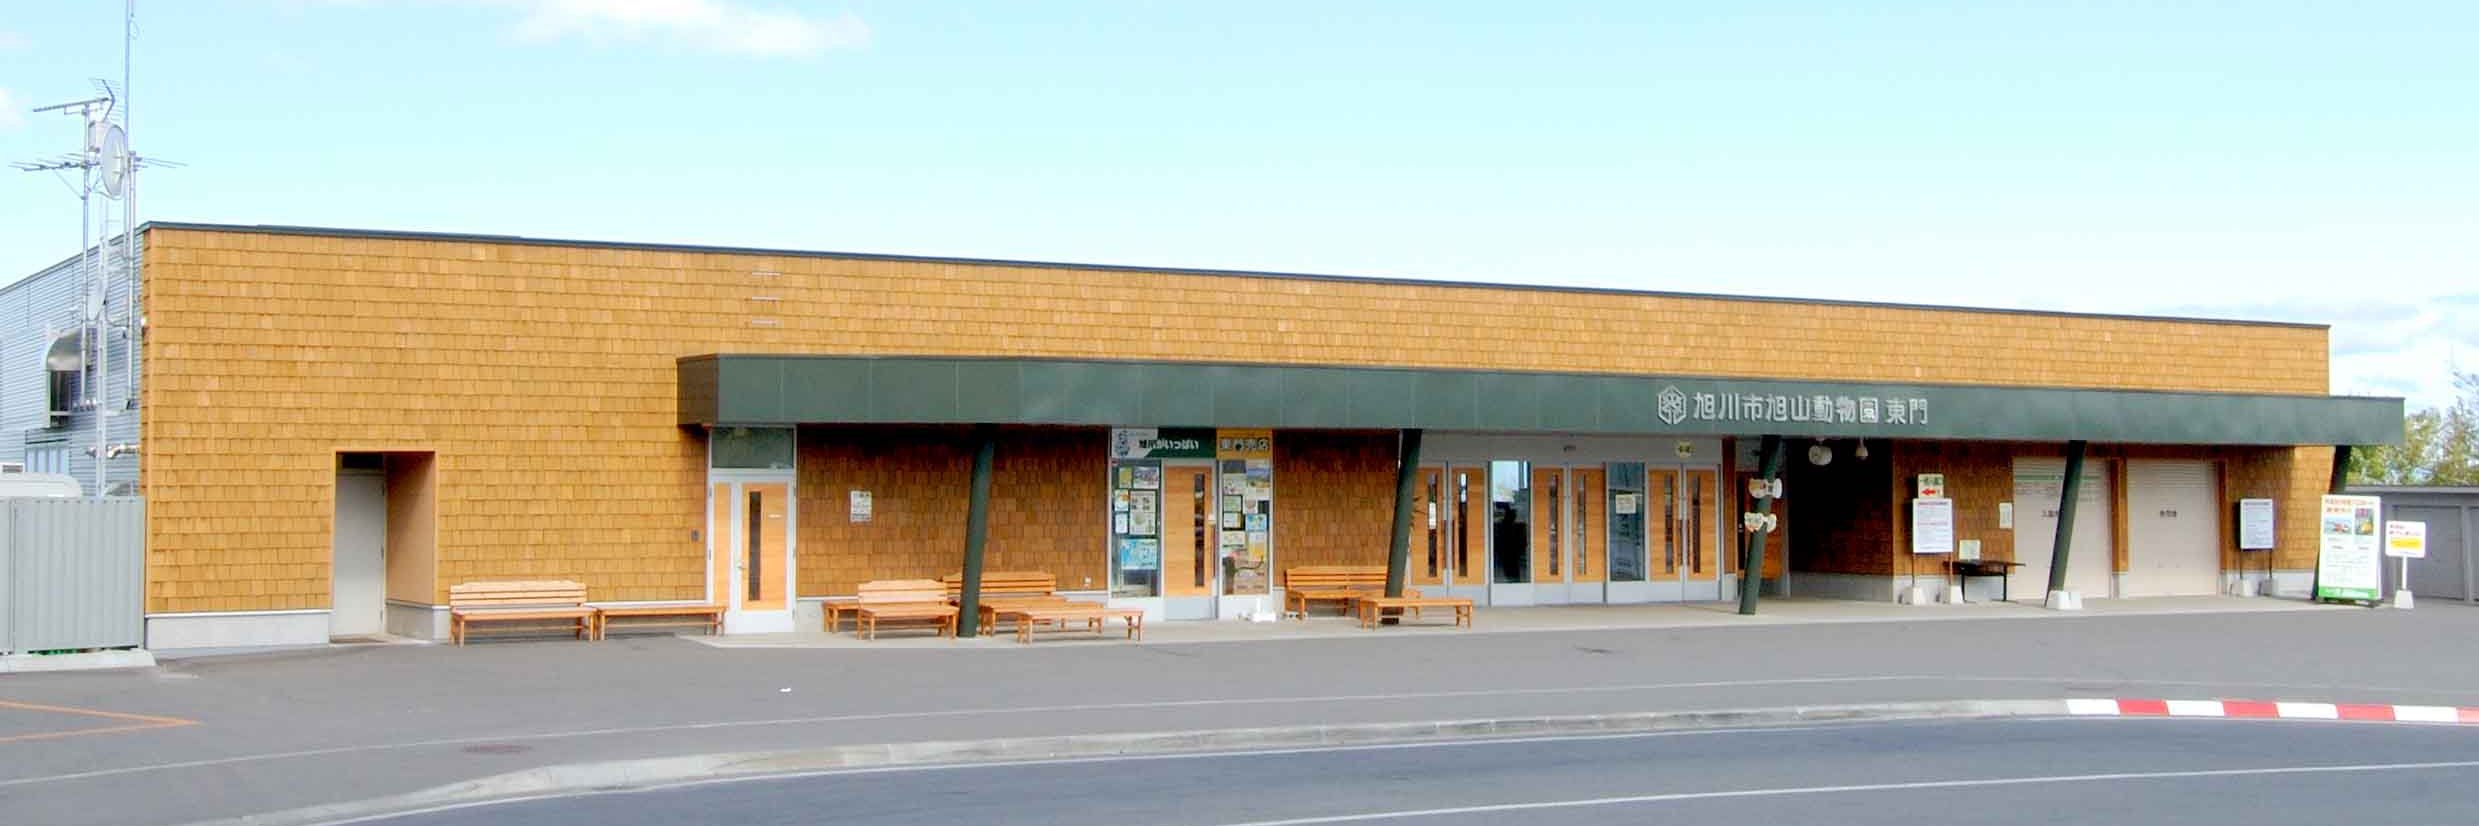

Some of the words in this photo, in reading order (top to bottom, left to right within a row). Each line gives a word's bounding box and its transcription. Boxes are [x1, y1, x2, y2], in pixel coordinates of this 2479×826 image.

[1693, 391, 1879, 424] 旭川市旭山動物園
[1885, 398, 1929, 425] 東門
